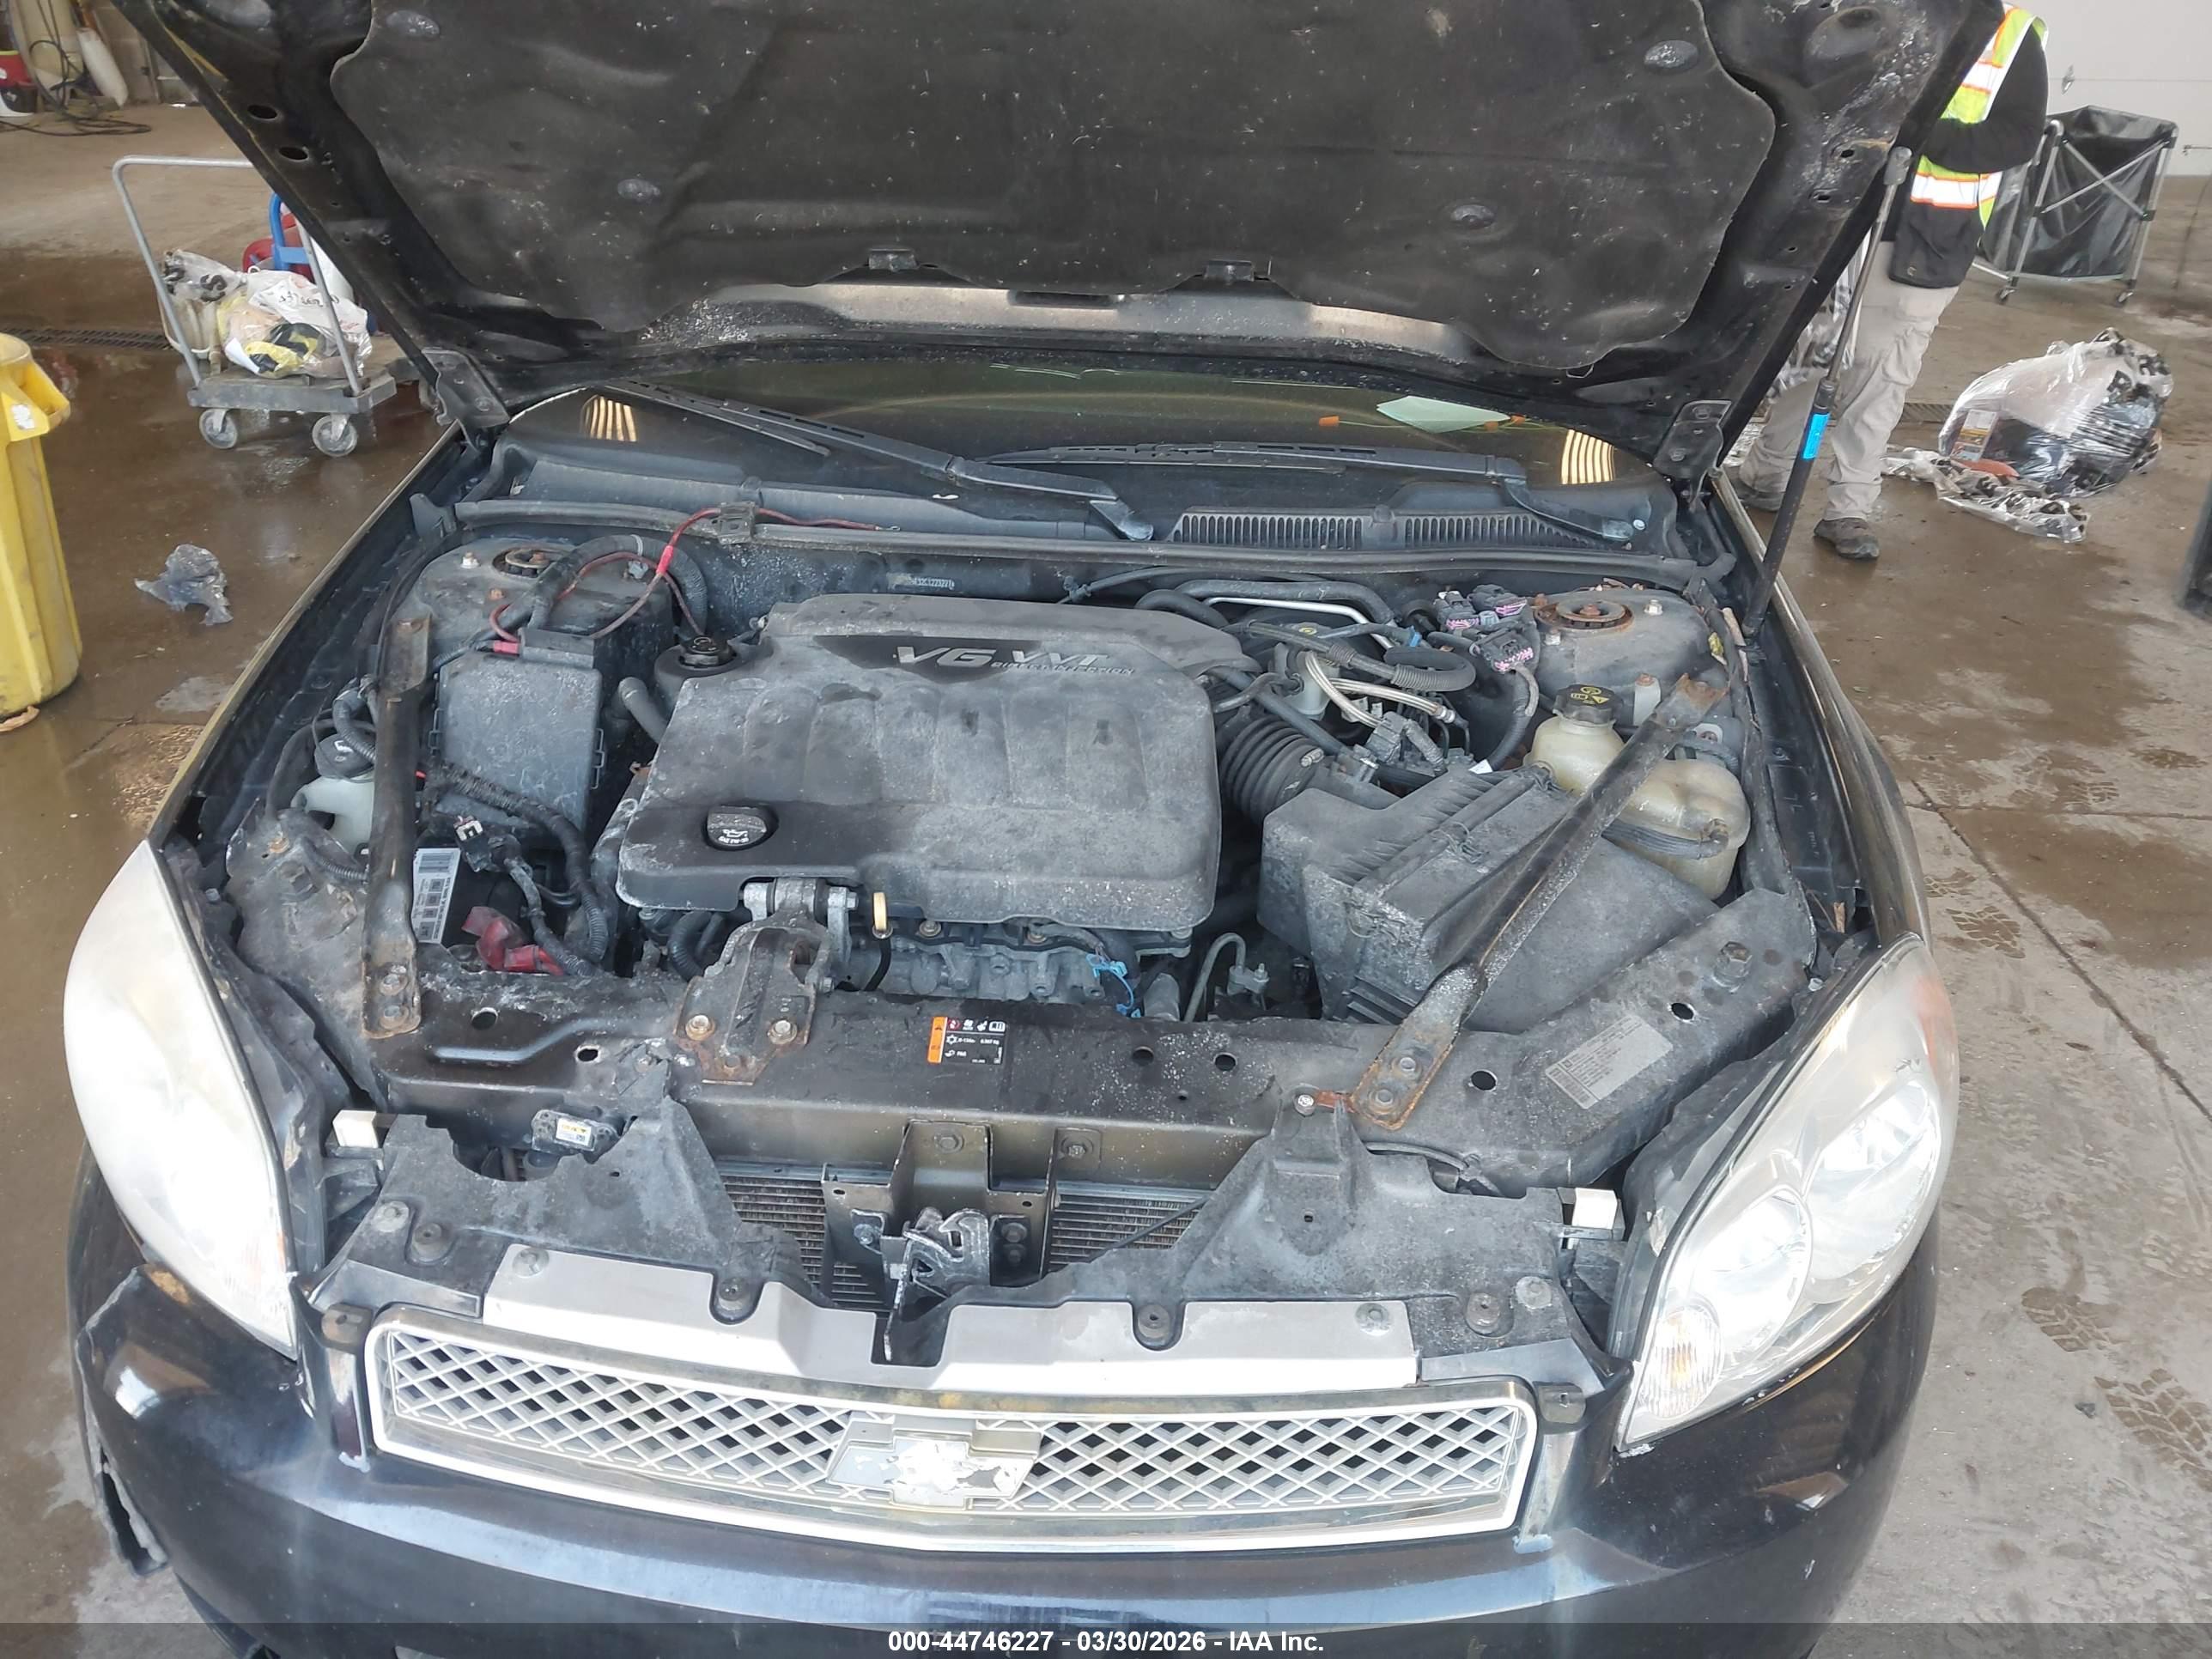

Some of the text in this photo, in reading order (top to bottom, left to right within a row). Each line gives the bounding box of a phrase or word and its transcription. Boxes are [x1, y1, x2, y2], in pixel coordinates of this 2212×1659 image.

[1012, 650, 1109, 665] VVT
[991, 661, 1135, 675] DIRECT INJECTION
